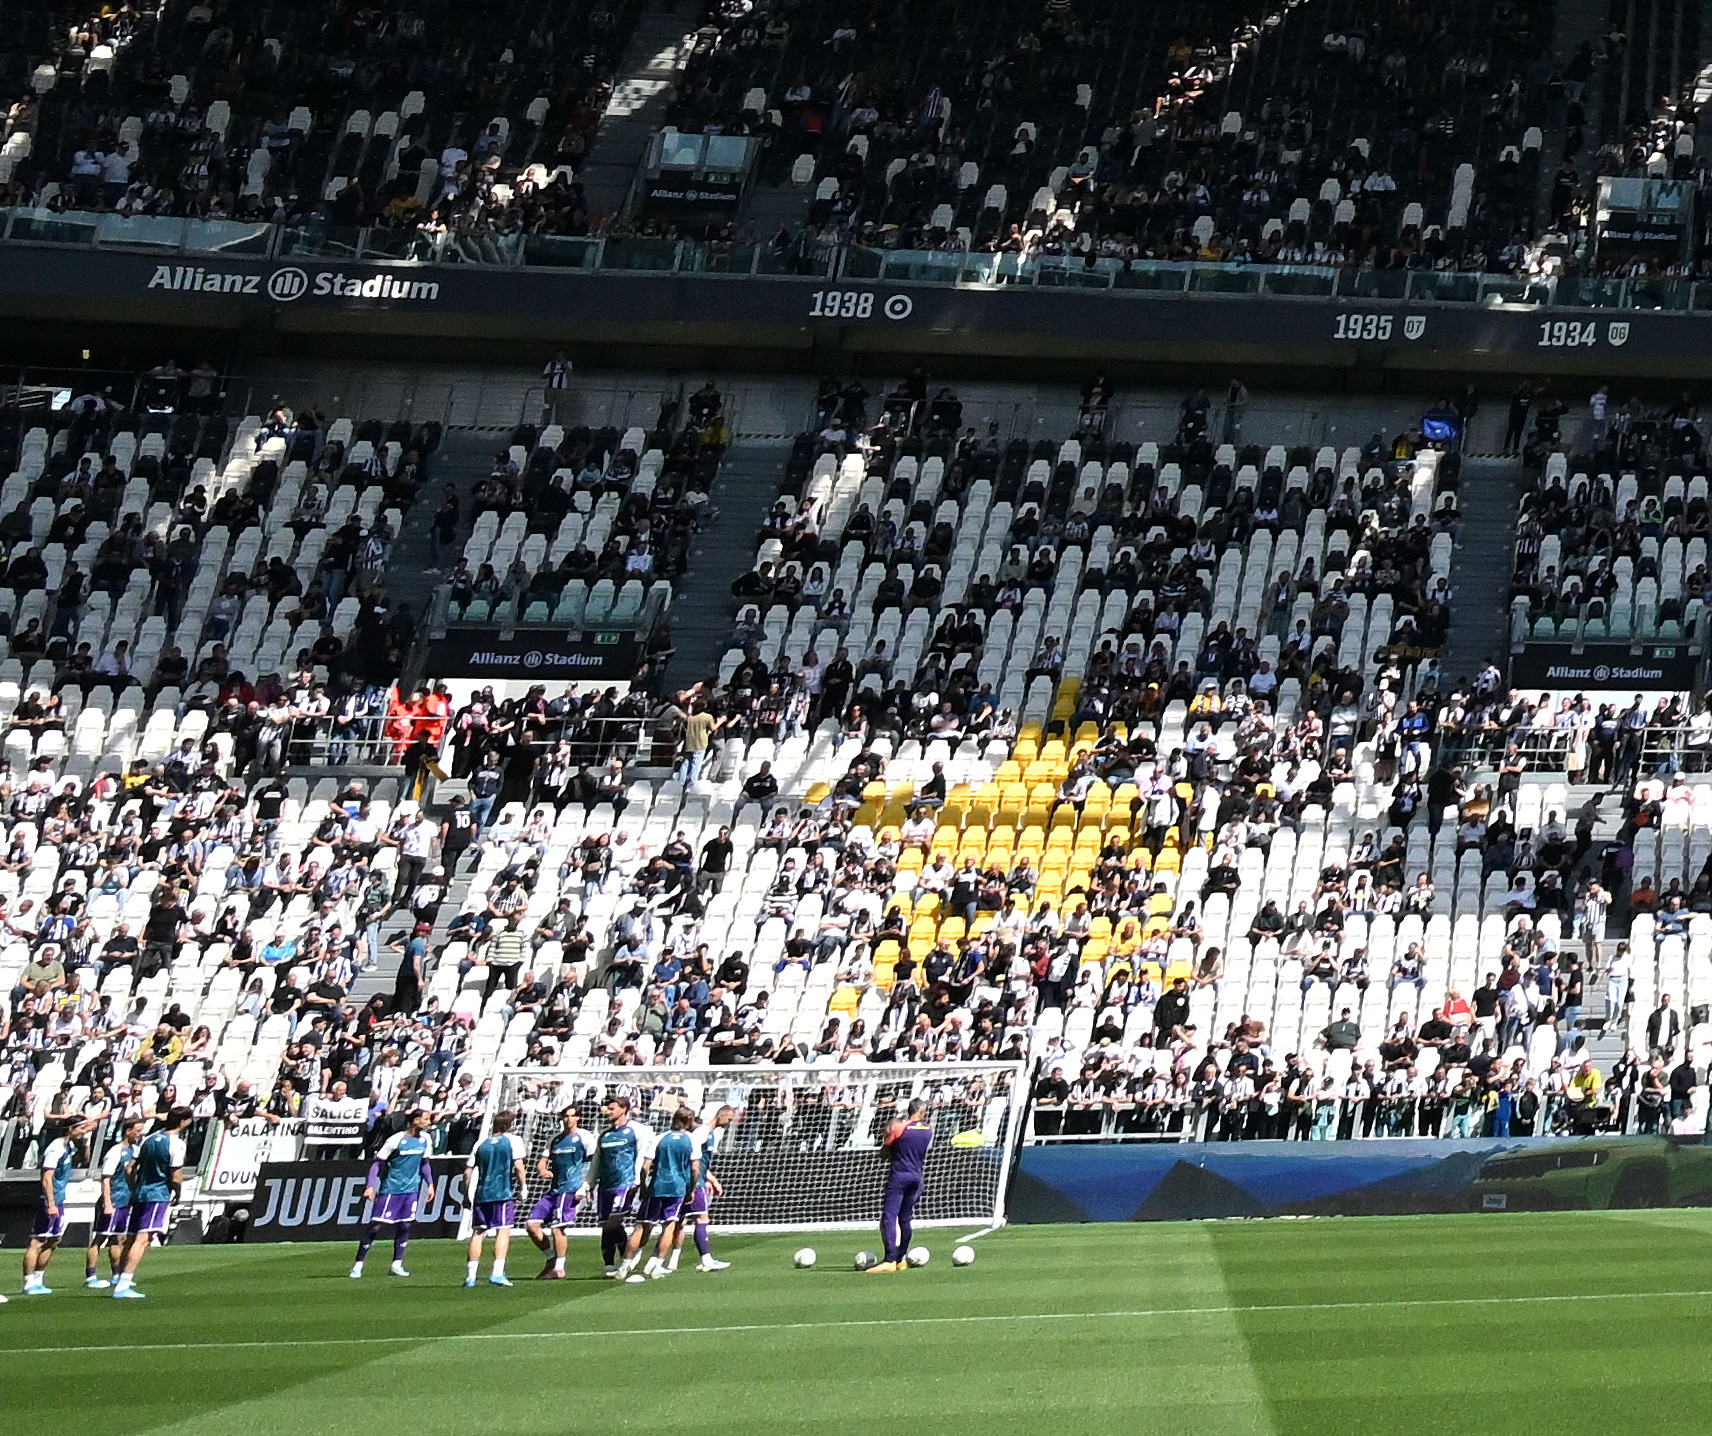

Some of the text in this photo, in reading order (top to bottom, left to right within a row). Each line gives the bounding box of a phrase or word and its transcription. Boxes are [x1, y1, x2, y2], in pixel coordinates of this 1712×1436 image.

[147, 265, 440, 301] Allianz Stadium
[808, 291, 874, 318] 1938
[1333, 314, 1394, 340] 1935
[1536, 321, 1596, 347] 1934
[469, 652, 604, 667] Allianz Stadium
[1546, 666, 1663, 679] Allianz Stadium
[455, 814, 471, 829] 10
[311, 1106, 362, 1119] SALICE
